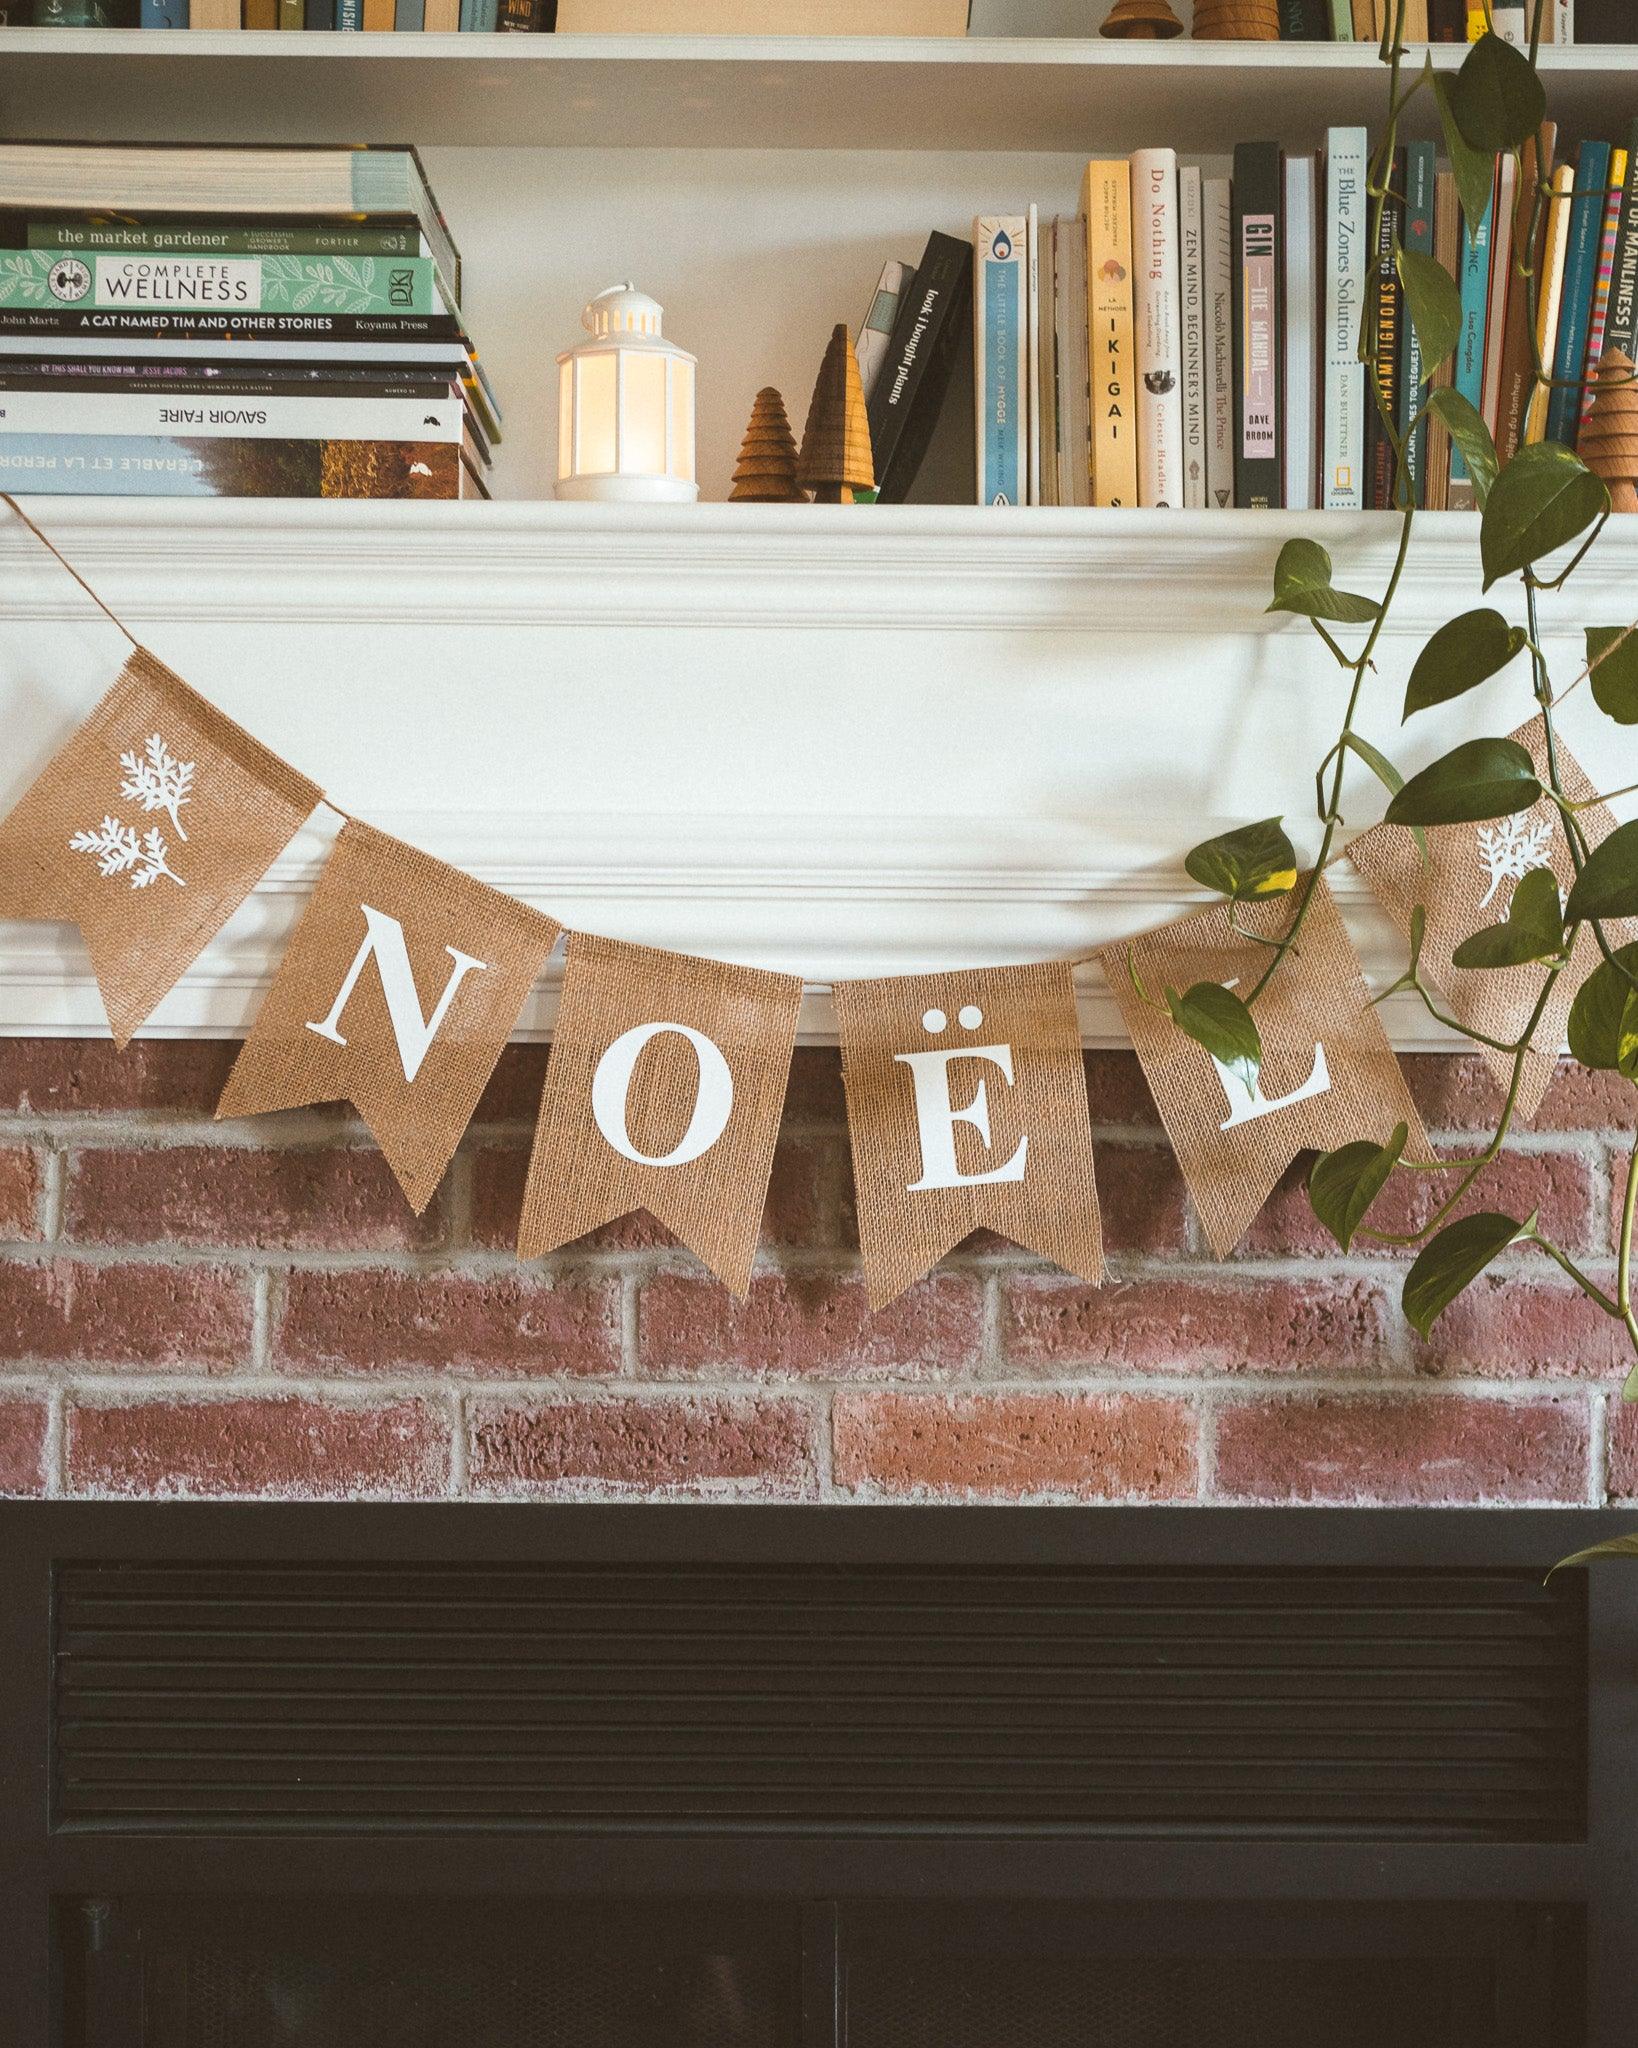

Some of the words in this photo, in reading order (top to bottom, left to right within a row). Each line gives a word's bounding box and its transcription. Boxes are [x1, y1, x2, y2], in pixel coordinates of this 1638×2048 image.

[1151, 168, 1165, 194] Do
[1338, 178, 1355, 215] Blue
[57, 230, 84, 243] the
[89, 230, 148, 244] market
[153, 231, 229, 248] gardener
[315, 237, 359, 246] FORTIER
[1149, 203, 1166, 280] Nothing
[1186, 229, 1198, 258] ZEN
[1245, 223, 1273, 257] GIN
[1338, 221, 1355, 273] Zones
[123, 264, 229, 279] COMPLETE
[997, 270, 1006, 289] THE
[1615, 231, 1638, 326] MANLINESS
[106, 277, 248, 301] WELLNESS
[391, 271, 412, 306] DK
[918, 288, 939, 314] look
[1251, 286, 1268, 312] THE
[1, 317, 27, 326] John
[29, 317, 60, 325] Martz
[997, 293, 1006, 324] LITTLE
[1337, 278, 1355, 352] Solution
[1467, 311, 1477, 331] Lisa
[80, 316, 91, 327] A
[92, 316, 119, 328] CAT
[120, 316, 169, 328] NAMED
[172, 316, 196, 328] TIM
[198, 317, 228, 329] AND
[230, 317, 276, 329] OTHER
[278, 317, 333, 329] STORIES
[355, 320, 398, 332] Koyama
[400, 320, 428, 330] Press
[902, 323, 927, 366] bought
[997, 329, 1006, 361] BOOK
[1187, 314, 1200, 398] BEGINNER'S
[1251, 320, 1268, 375] MANUAL
[1410, 337, 1420, 349] ET
[1465, 331, 1477, 374] Congdon
[41, 364, 50, 373] BY
[51, 364, 66, 373] THIS
[67, 364, 87, 373] SHALL
[88, 365, 101, 374] YOU
[102, 365, 122, 374] KNOW
[122, 365, 136, 374] HIM
[142, 366, 162, 375] JESSE
[162, 366, 187, 376] JACOBS
[997, 365, 1006, 380] OF
[1214, 335, 1227, 392] Machiavelli
[888, 366, 910, 406] plants
[1107, 318, 1122, 439] IKIGAI
[1340, 374, 1348, 398] DAN
[997, 385, 1007, 425] HYGGE
[1215, 395, 1227, 415] The
[1509, 372, 1522, 415] bonheur
[159, 409, 203, 423] FAIRE
[209, 410, 267, 424] SAVOIR
[1156, 403, 1166, 445] Celeste
[1188, 403, 1201, 446] MIND
[1248, 414, 1270, 425] DAVE
[1340, 401, 1349, 458] BUETTNER
[1508, 417, 1521, 430] du
[1215, 417, 1226, 450] Prince
[1245, 430, 1273, 441] BROOM
[1409, 428, 1417, 464] PLANT
[64, 456, 85, 469] LA
[92, 457, 113, 470] ET
[121, 458, 202, 474] L'ÉRABLE
[1157, 449, 1168, 496] Headlee
